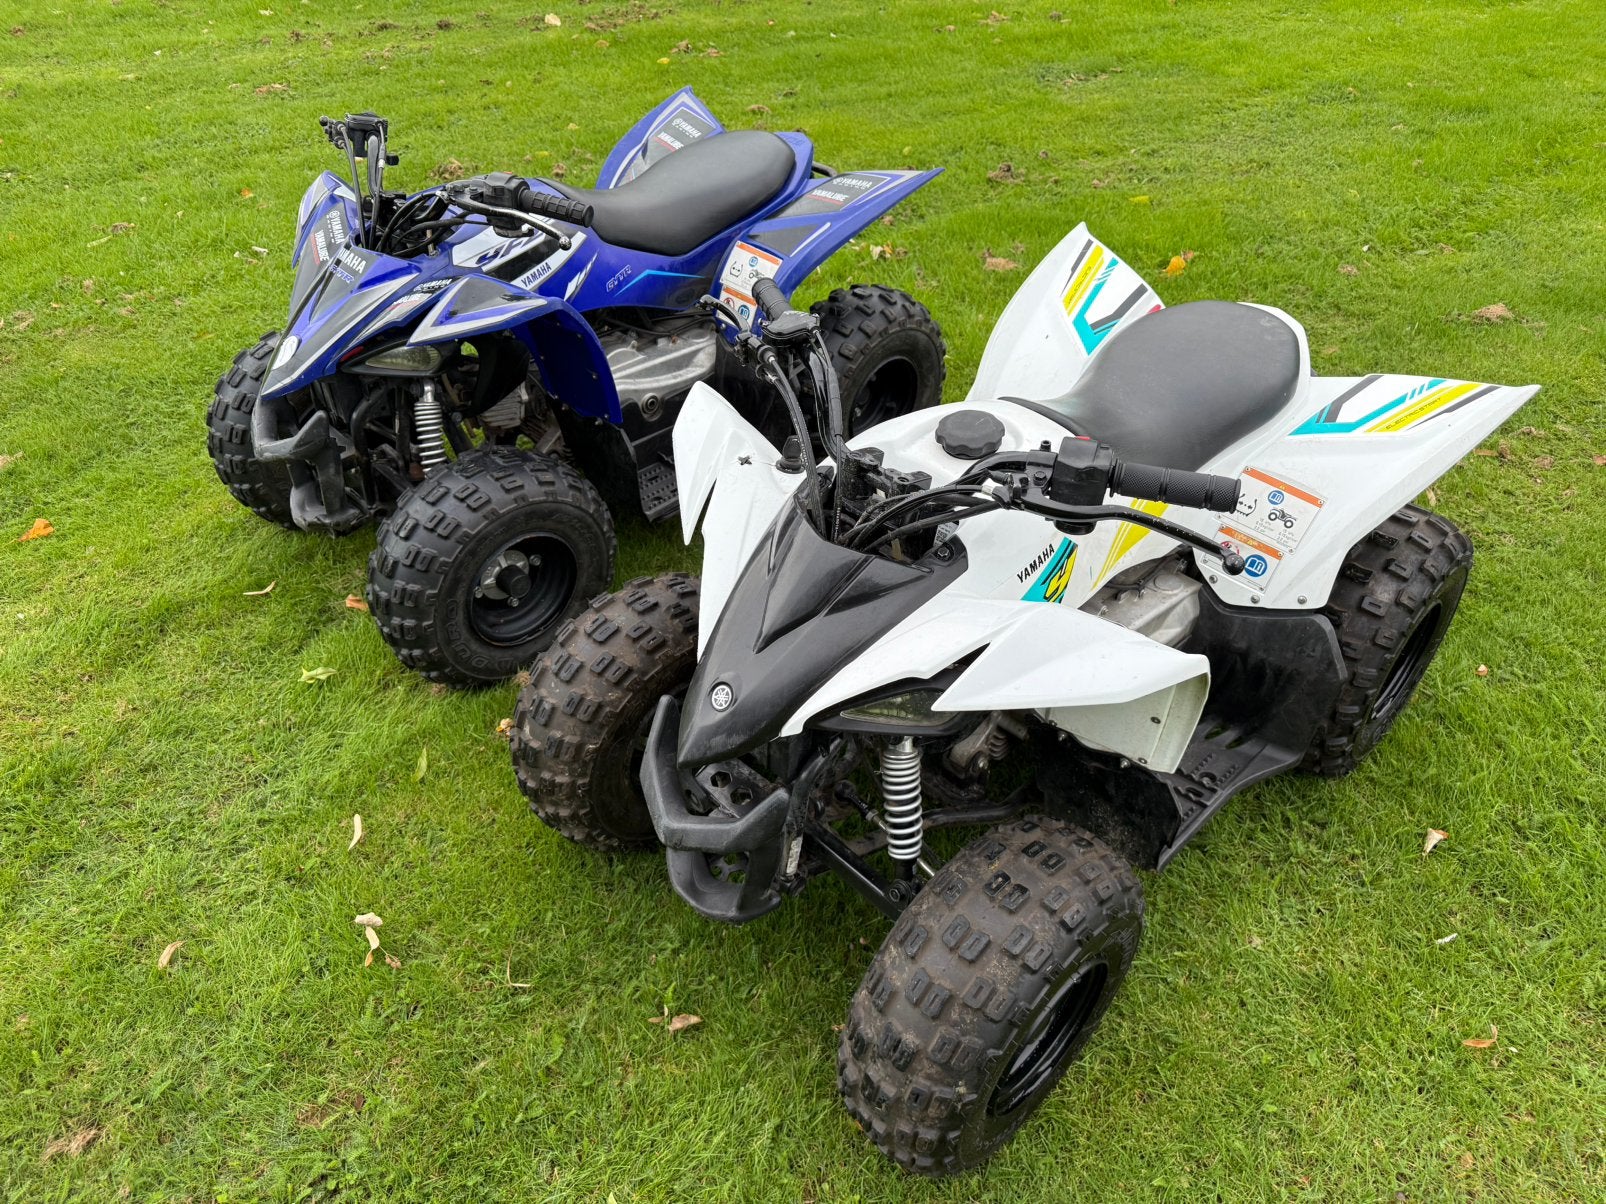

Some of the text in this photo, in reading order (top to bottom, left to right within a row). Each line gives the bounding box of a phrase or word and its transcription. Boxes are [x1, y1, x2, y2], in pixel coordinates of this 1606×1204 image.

[679, 119, 702, 138] YAMAHA
[811, 189, 846, 202] YAMALUBE
[842, 177, 873, 188] YAMAHA
[330, 216, 346, 245] YAMAHA
[314, 229, 330, 262] YAMALUBE
[521, 262, 552, 288] YAMAHA
[1016, 543, 1055, 584] YAMAHA
